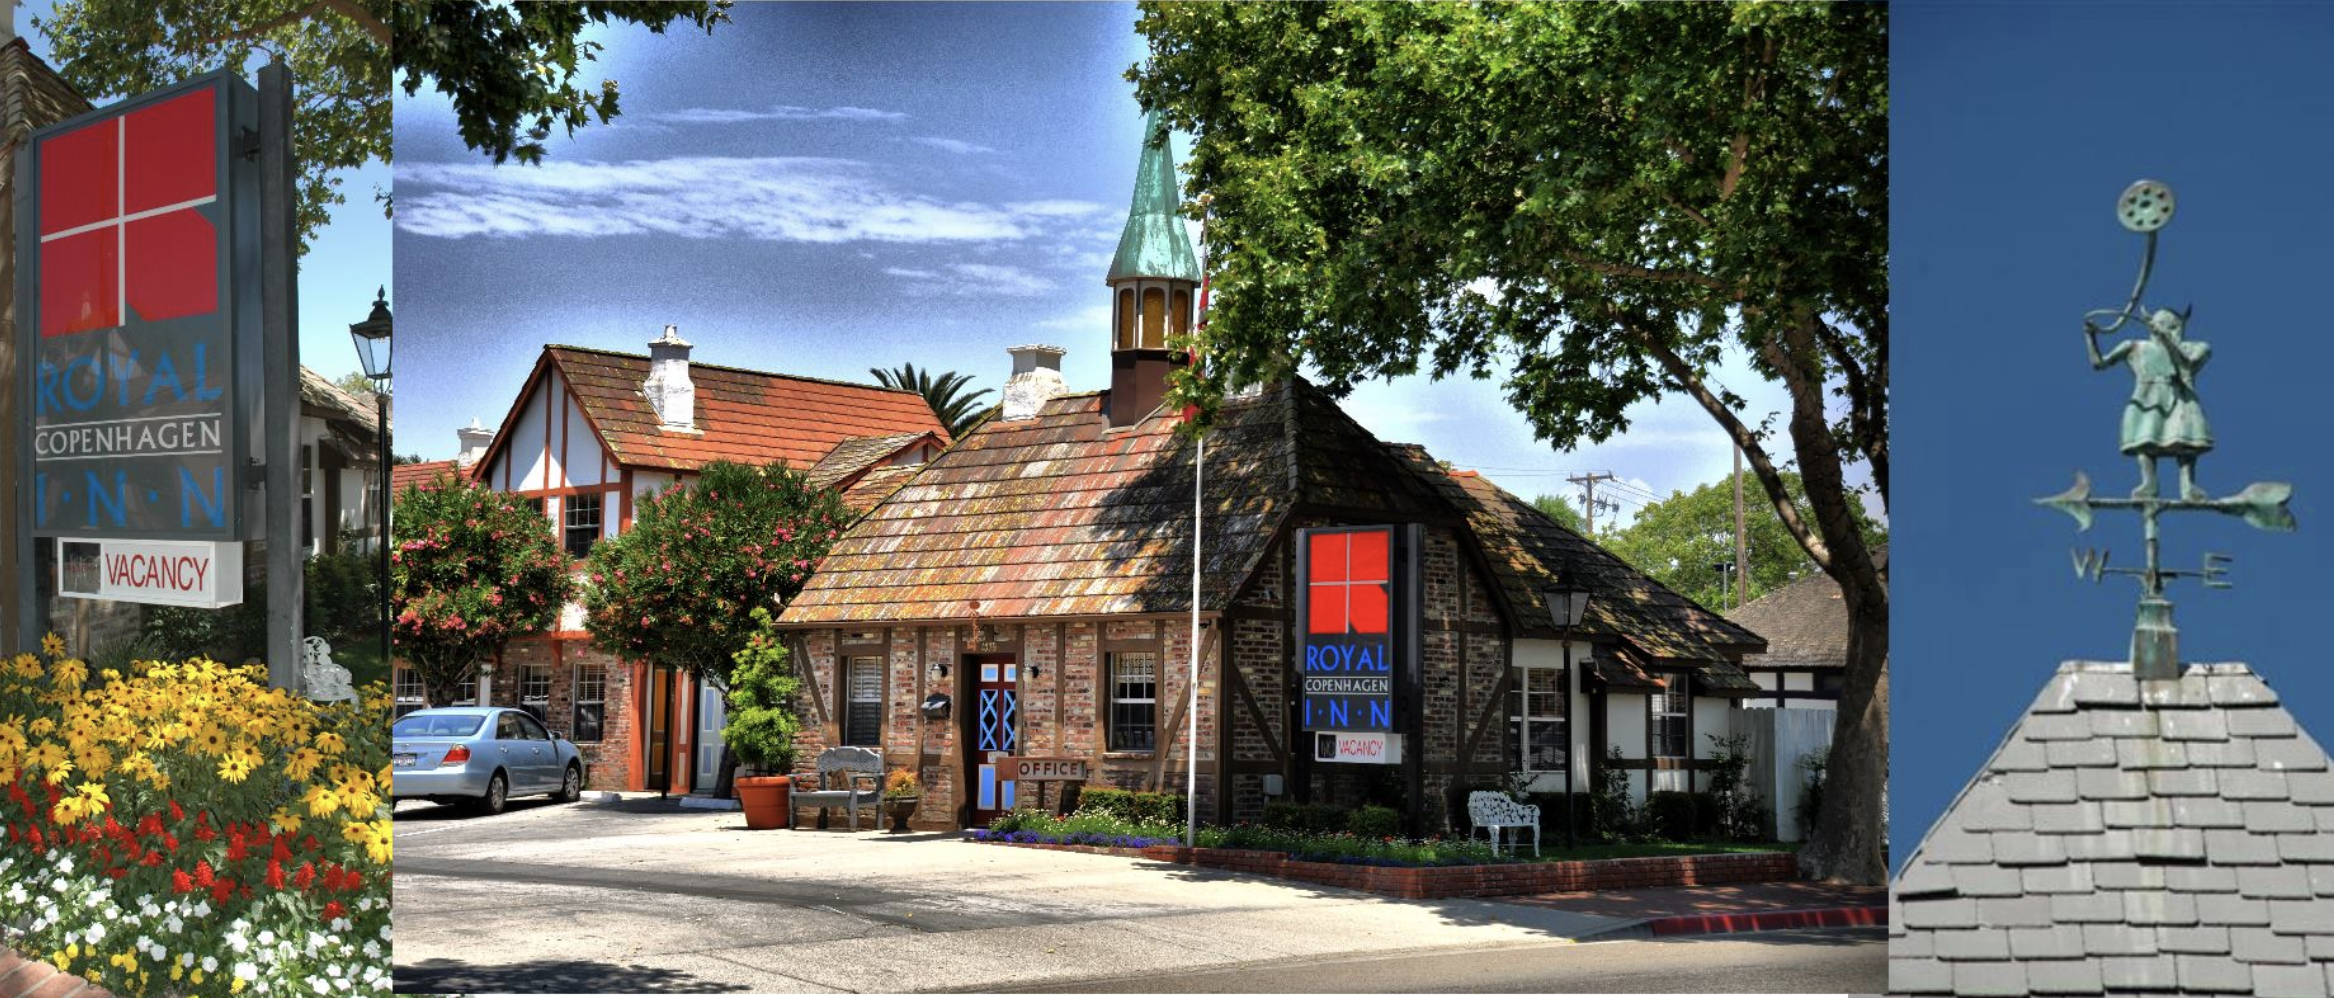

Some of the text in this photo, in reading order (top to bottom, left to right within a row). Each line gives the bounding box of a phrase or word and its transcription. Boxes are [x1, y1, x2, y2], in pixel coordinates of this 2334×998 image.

[36, 344, 223, 416] ROYAL
[35, 420, 221, 455] COPENHAGEN
[106, 553, 209, 592] VACANCY
[2071, 548, 2233, 589] W E
[1306, 645, 1389, 671] ROYAL
[1305, 679, 1388, 692] COPENHAGEN
[1339, 739, 1383, 756] VACANCY
[1019, 762, 1078, 775] OFFICE
